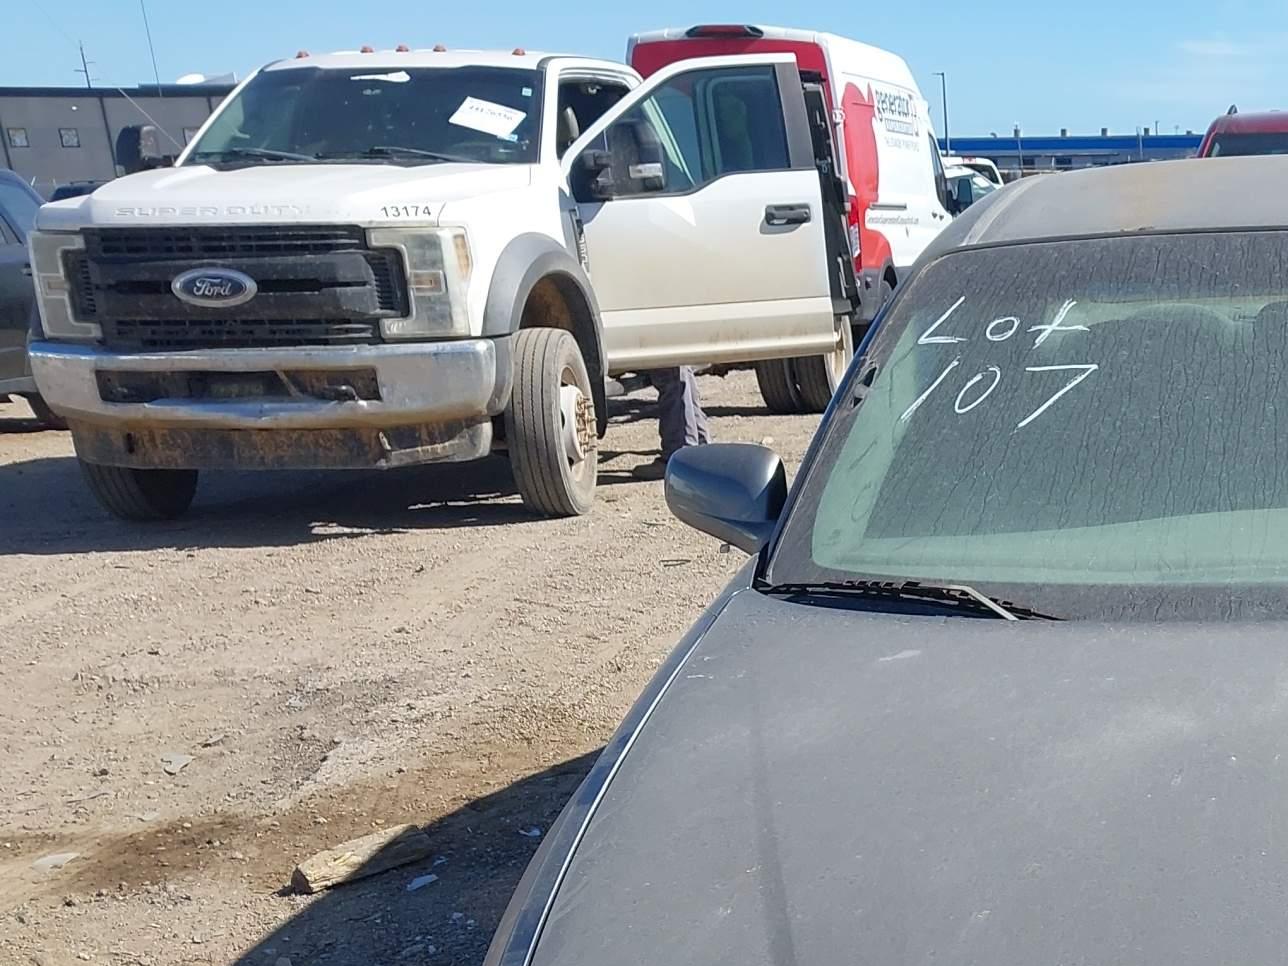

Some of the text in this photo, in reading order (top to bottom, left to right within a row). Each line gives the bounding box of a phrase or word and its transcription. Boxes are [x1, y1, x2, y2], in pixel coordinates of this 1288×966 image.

[114, 204, 304, 218] SUPER DUTY
[380, 205, 432, 218] 13174
[193, 277, 233, 297] Ford
[917, 296, 1090, 350] Lot
[900, 353, 1099, 436] 107
